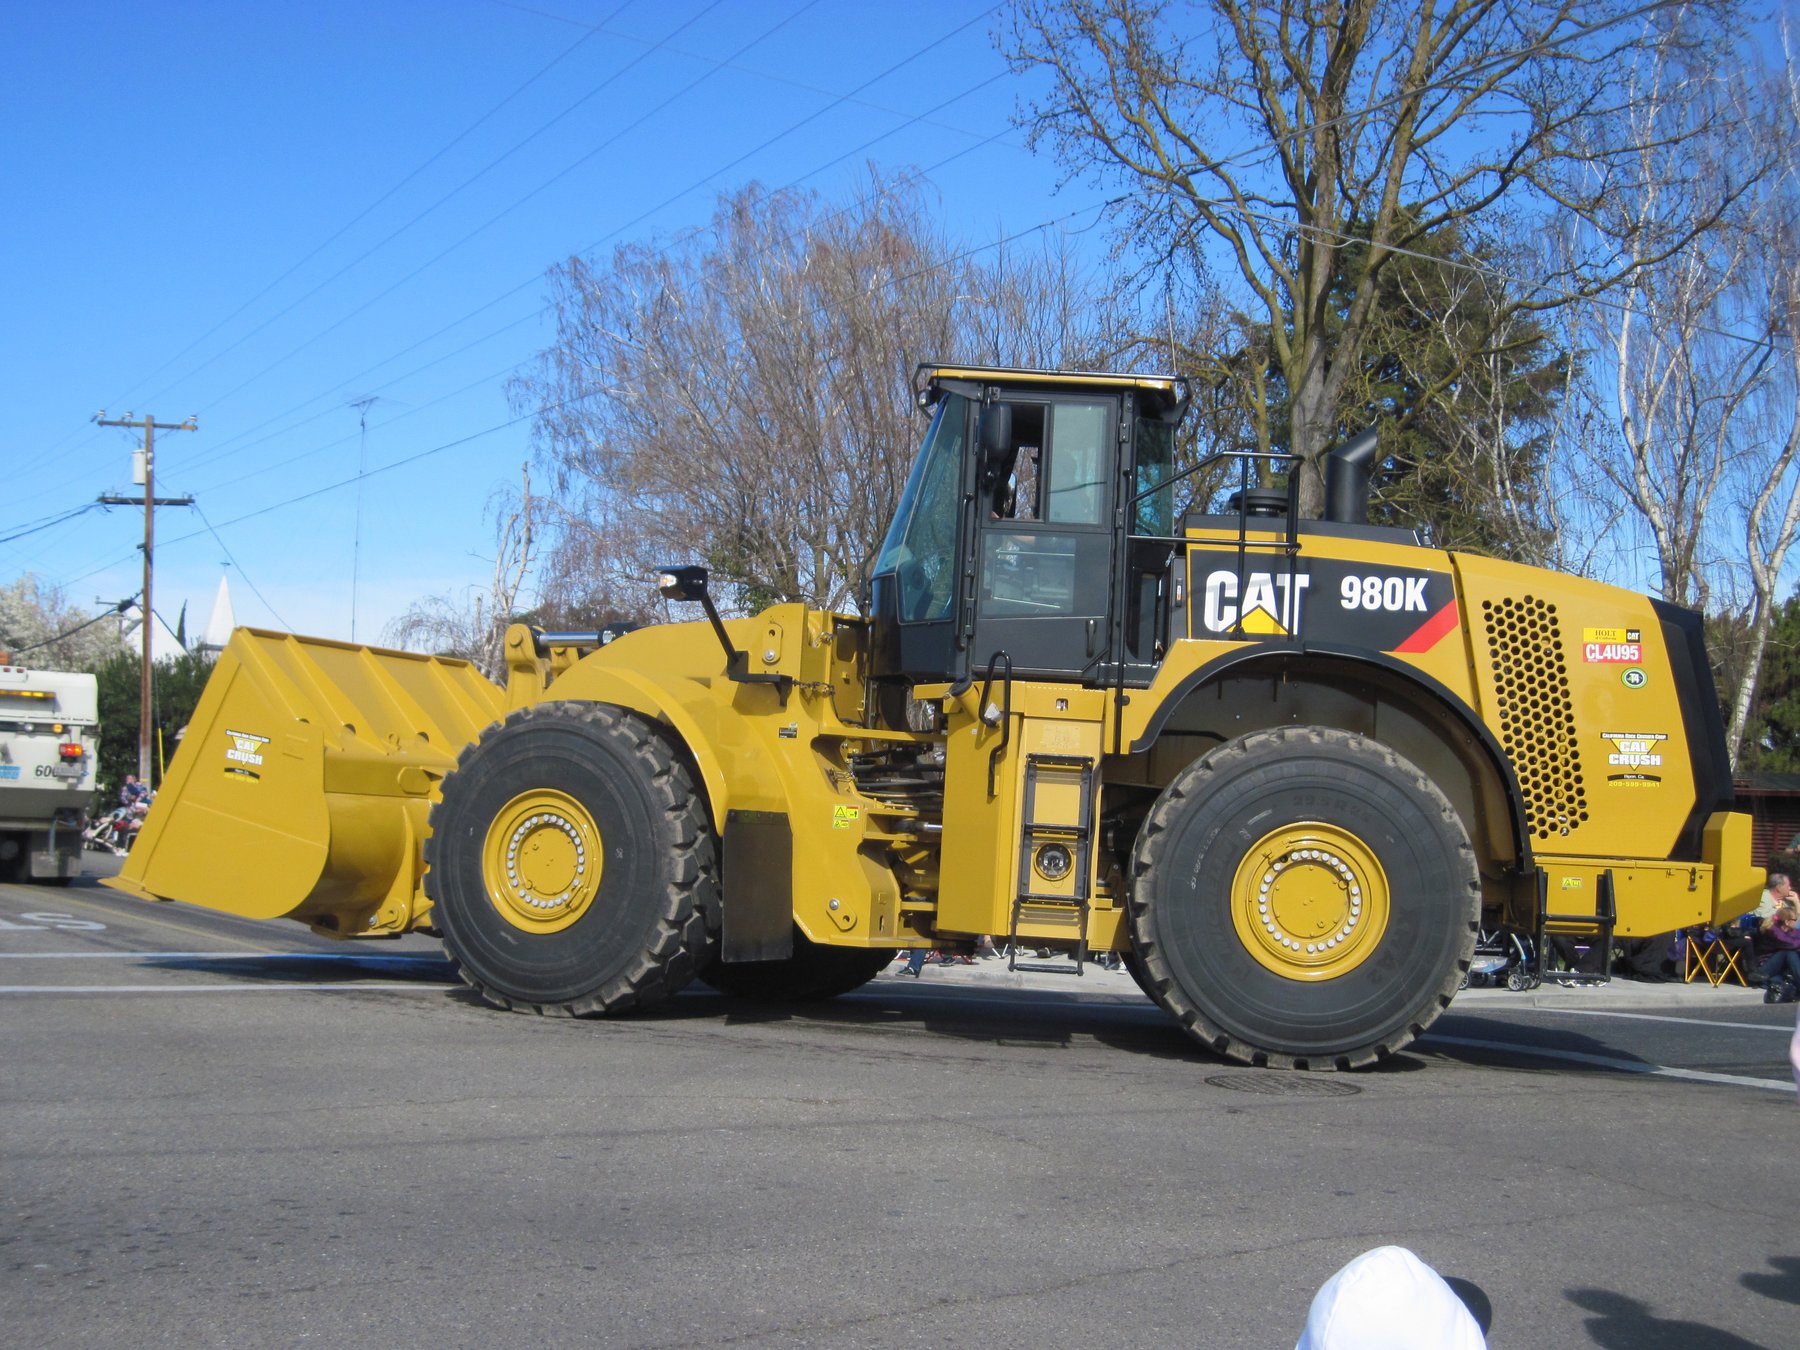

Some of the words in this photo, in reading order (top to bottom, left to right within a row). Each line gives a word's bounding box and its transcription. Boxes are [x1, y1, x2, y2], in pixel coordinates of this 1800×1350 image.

[1340, 575, 1429, 612] 980K
[1204, 570, 1310, 635] CAT
[1595, 629, 1616, 637] HOLT
[1626, 632, 1640, 640] CAT
[1585, 643, 1640, 660] CL4U95
[1619, 741, 1648, 753] CAL
[1608, 753, 1662, 766] CRUSH
